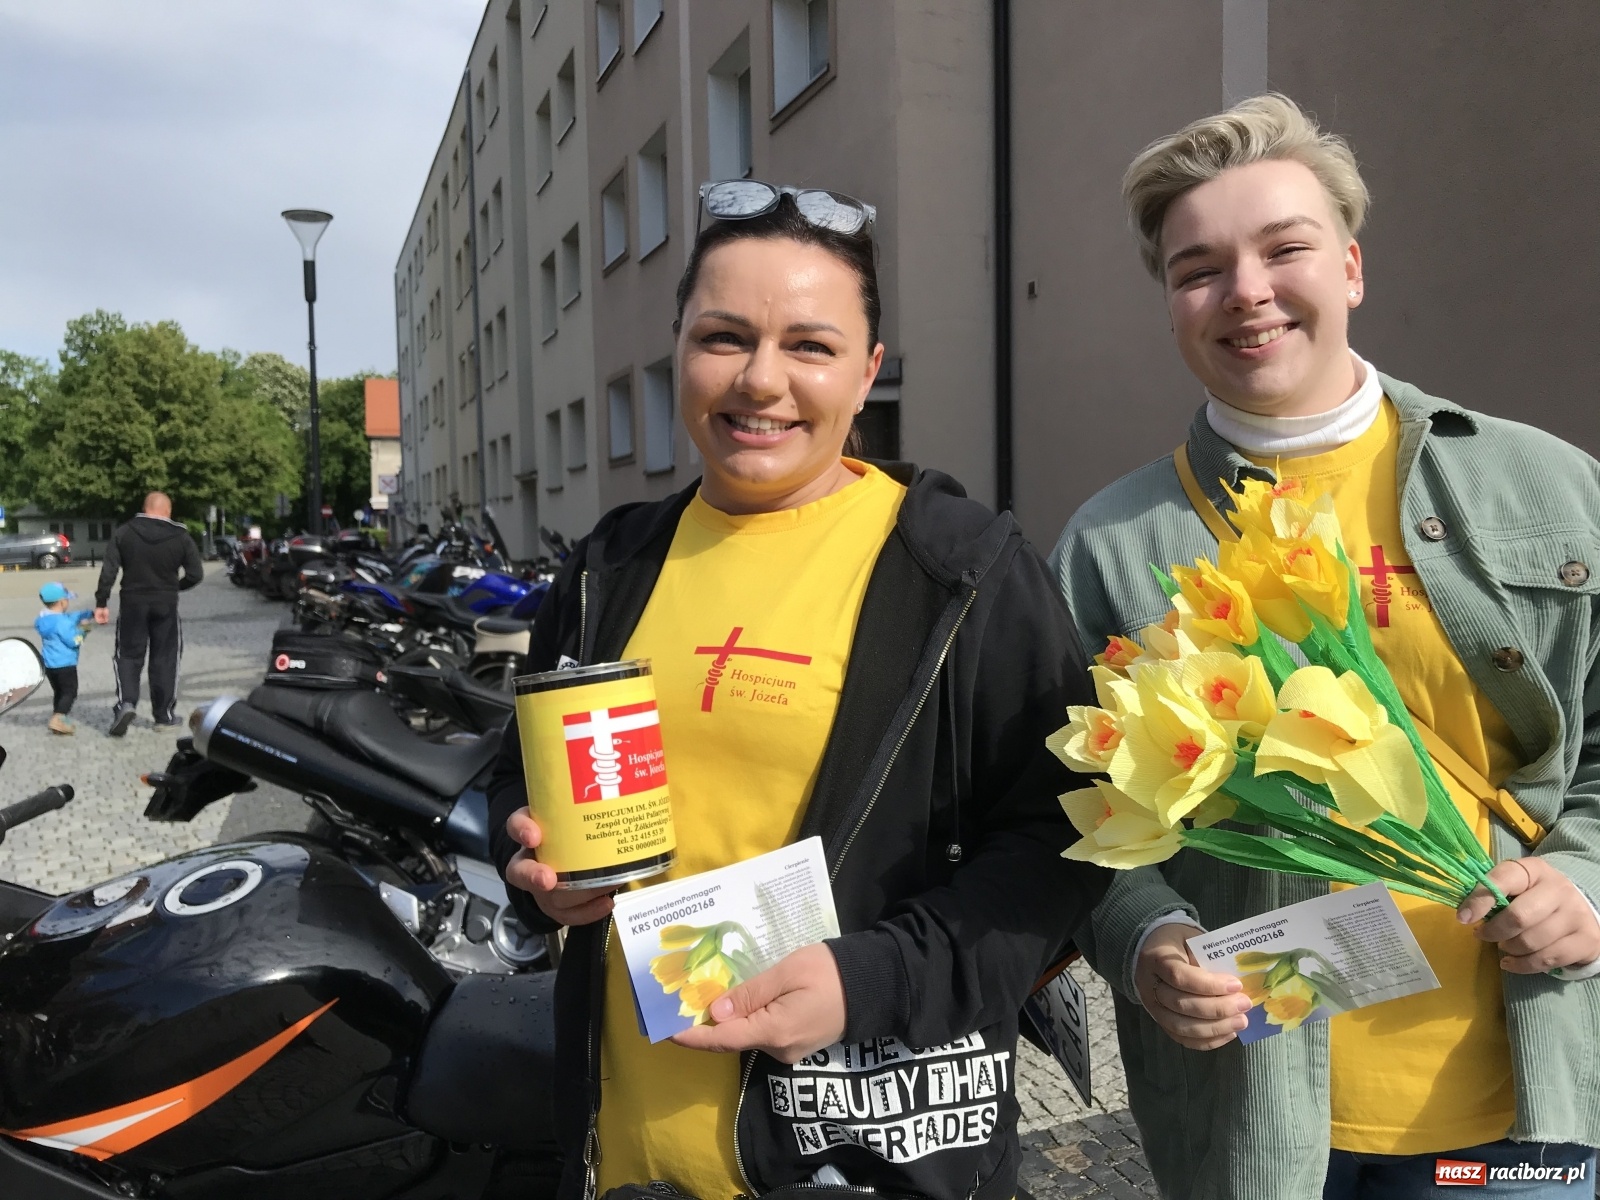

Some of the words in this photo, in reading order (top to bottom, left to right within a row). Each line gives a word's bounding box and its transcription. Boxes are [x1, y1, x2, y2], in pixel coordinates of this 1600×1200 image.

[730, 669, 796, 689] Hospicjum
[730, 686, 747, 698] św.
[749, 689, 788, 705] Józefa
[634, 767, 648, 778] św.
[583, 806, 634, 822] HOSPICJUM
[635, 804, 647, 812] IM.
[596, 819, 620, 830] Zespół
[622, 814, 644, 826] Opieki
[585, 830, 622, 841] Racibórz,
[640, 832, 651, 840] 415
[616, 844, 634, 855] KRS
[628, 884, 721, 922] #WiemJestemPomagam
[631, 921, 651, 935] KRS
[653, 897, 715, 927] 0000002168
[1202, 918, 1288, 950] #WiemJestemPomagam
[1206, 949, 1225, 961] KRS
[1226, 929, 1285, 954] 0000002168
[768, 1066, 919, 1119] BEAUTY
[928, 1051, 1010, 1105] THAT
[913, 1107, 996, 1153] FADES
